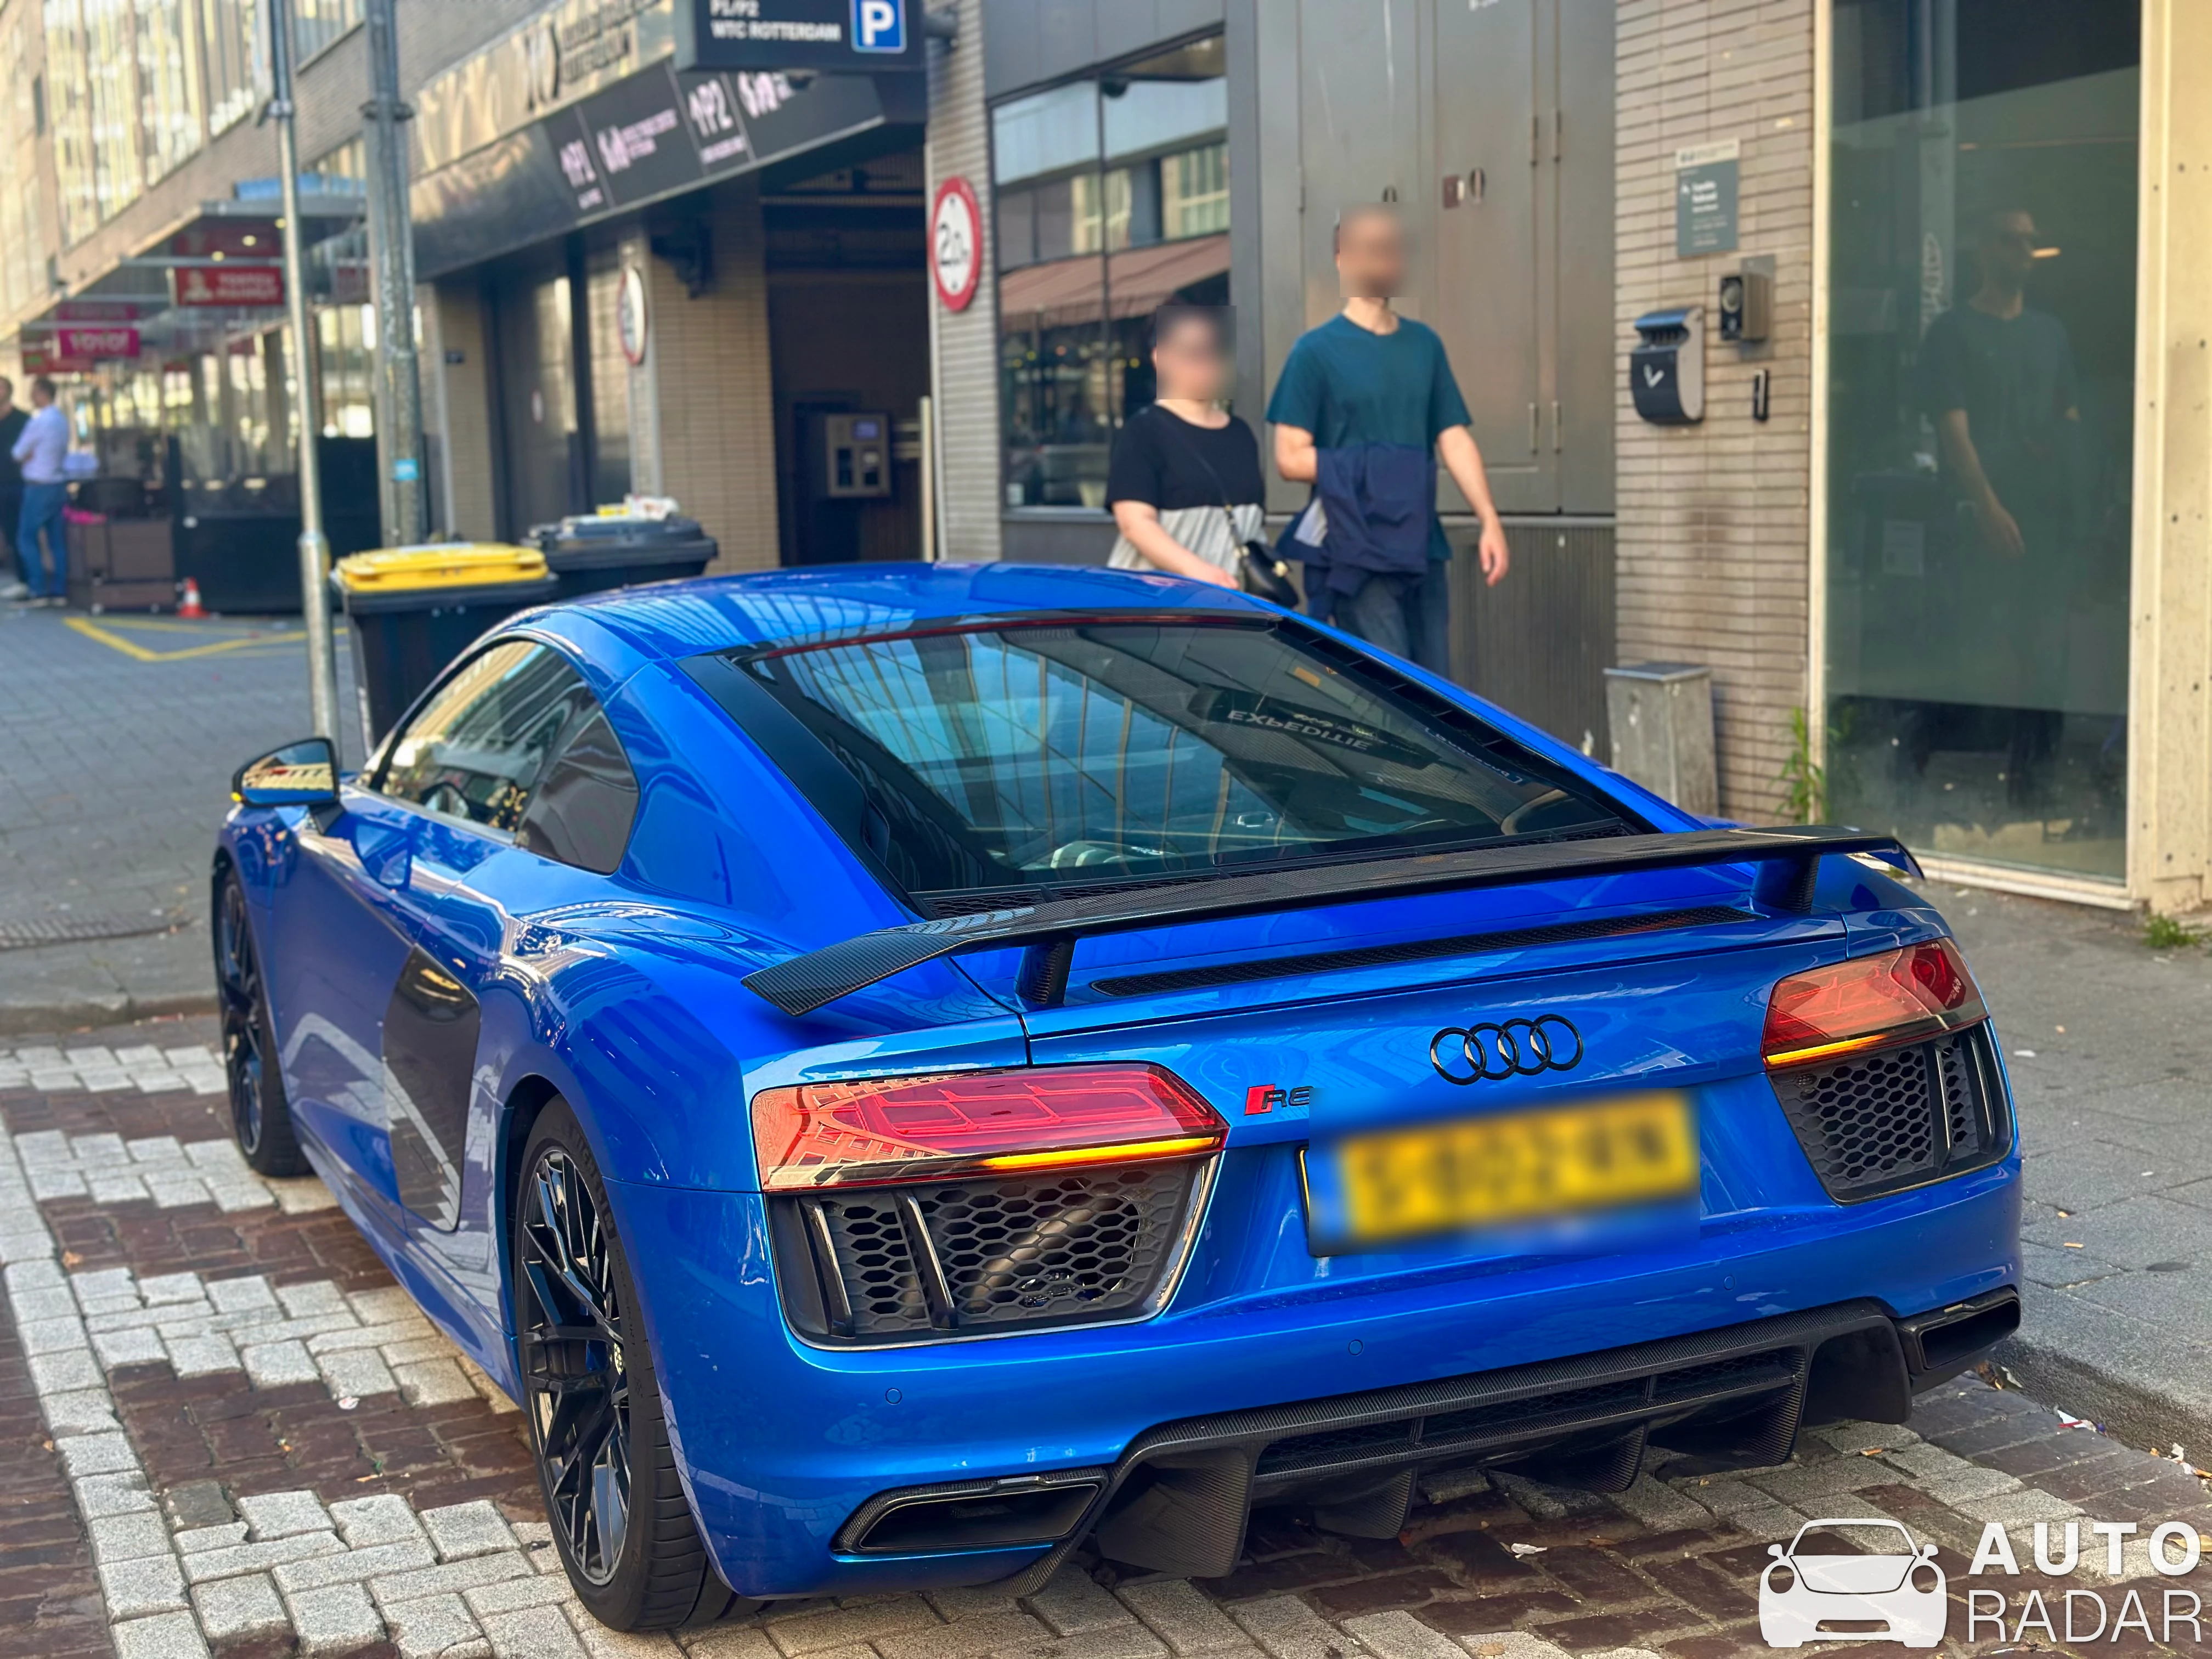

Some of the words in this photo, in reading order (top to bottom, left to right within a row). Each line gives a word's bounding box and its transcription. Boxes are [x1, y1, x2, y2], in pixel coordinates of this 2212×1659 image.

[711, 20, 747, 39] WTC
[749, 21, 842, 41] ROTTERDAM
[860, 0, 895, 46] P
